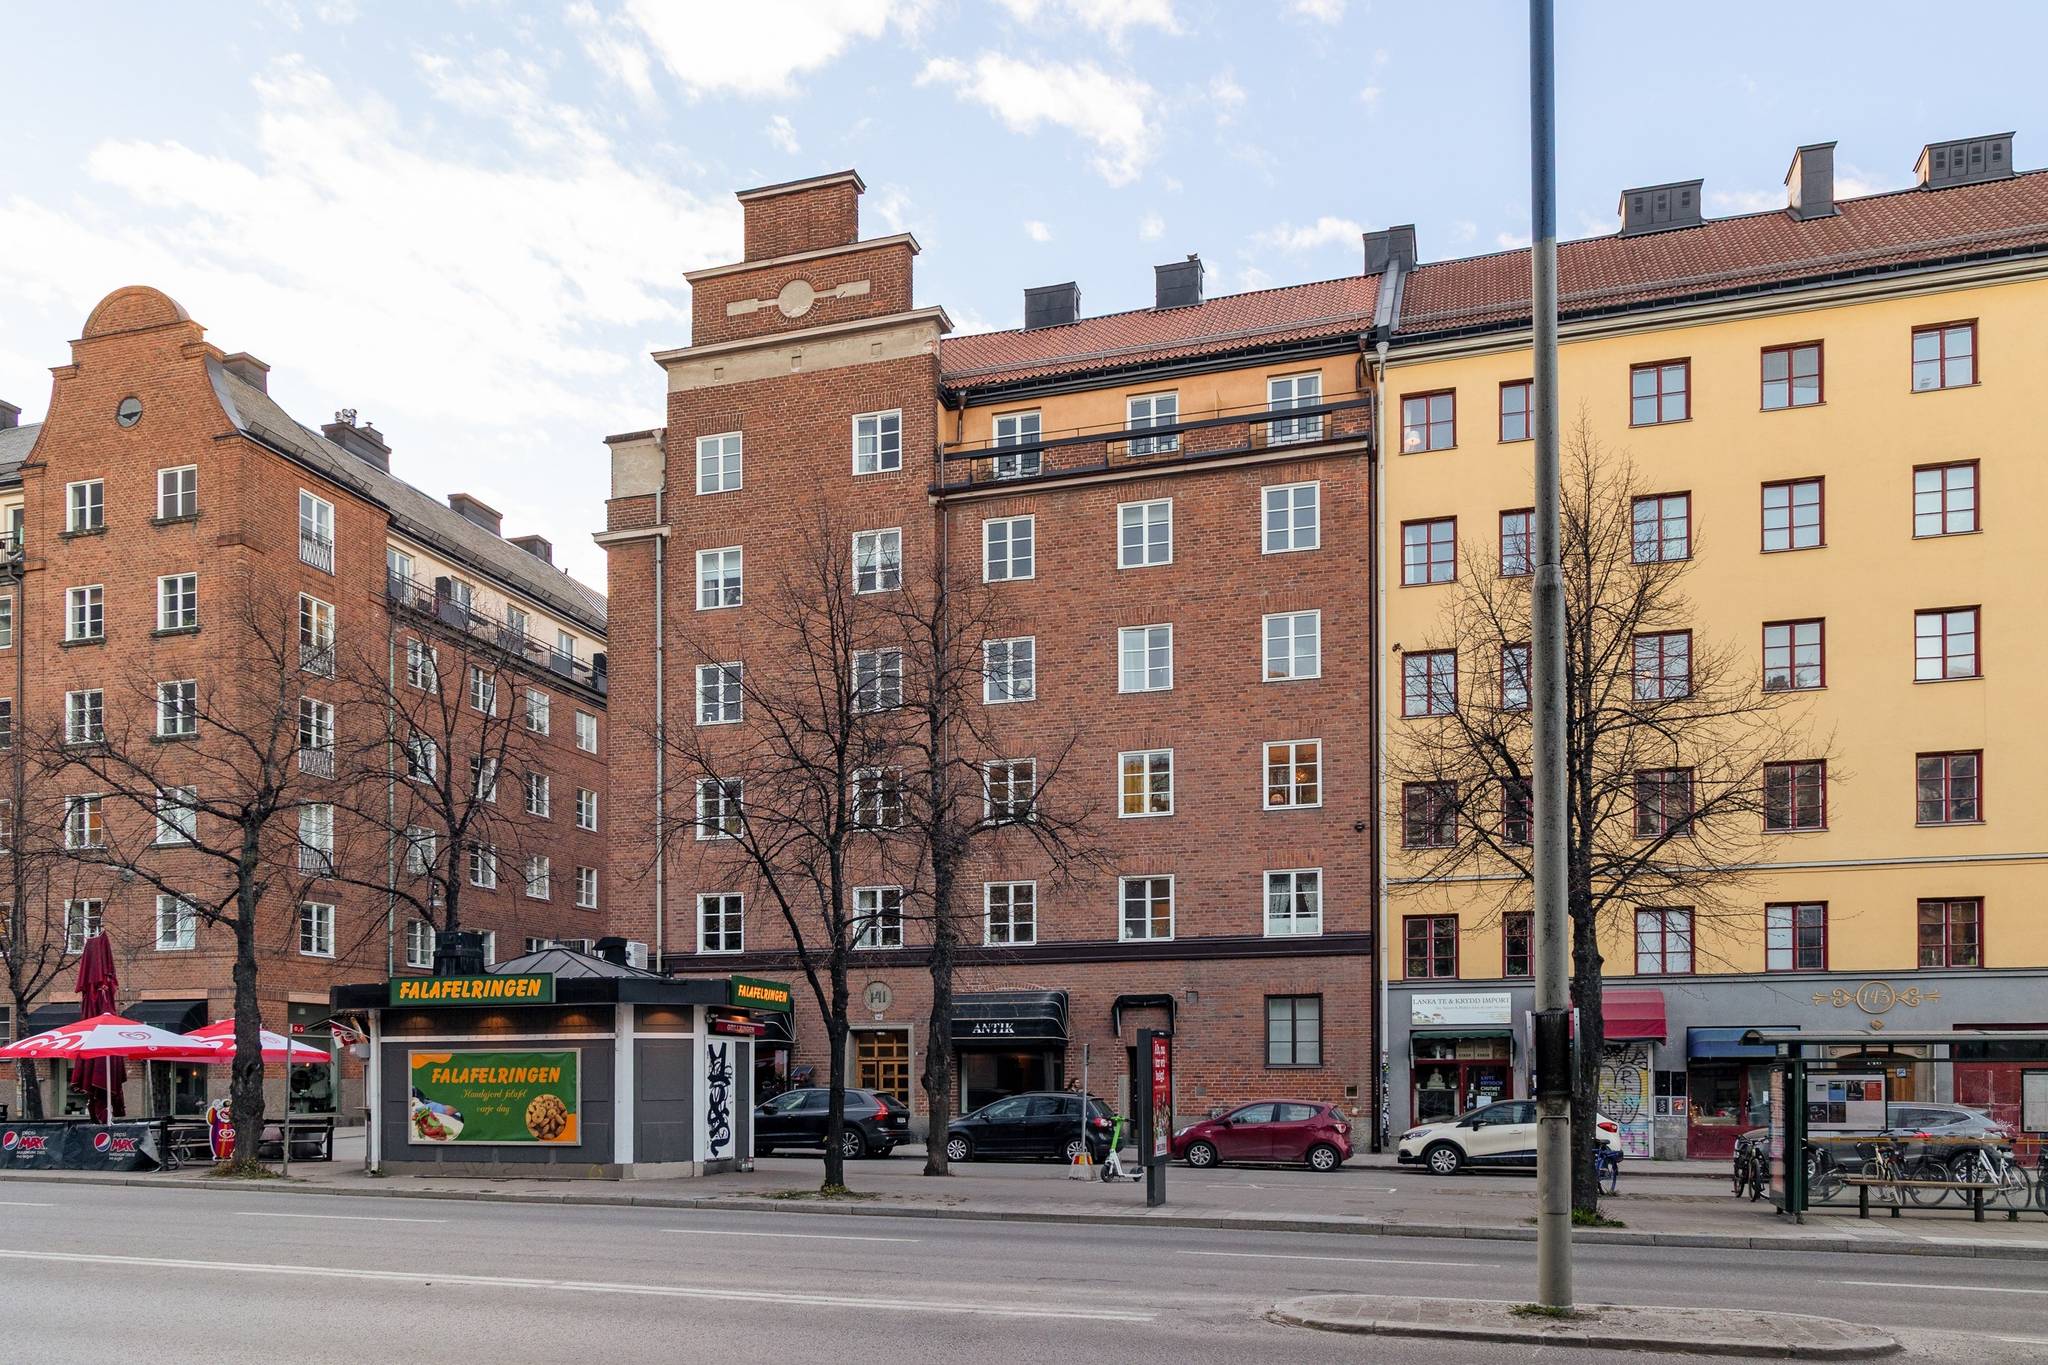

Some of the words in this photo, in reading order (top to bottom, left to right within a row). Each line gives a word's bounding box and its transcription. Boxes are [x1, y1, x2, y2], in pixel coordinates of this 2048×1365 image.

[400, 979, 541, 999] FALAFELRINGEN
[738, 984, 788, 1003] FALAFELRINGEN
[1863, 988, 1890, 1004] 143
[972, 1023, 1015, 1034] ANTIK
[432, 1067, 560, 1084] FALAFELRINGEN
[496, 1104, 510, 1115] dag
